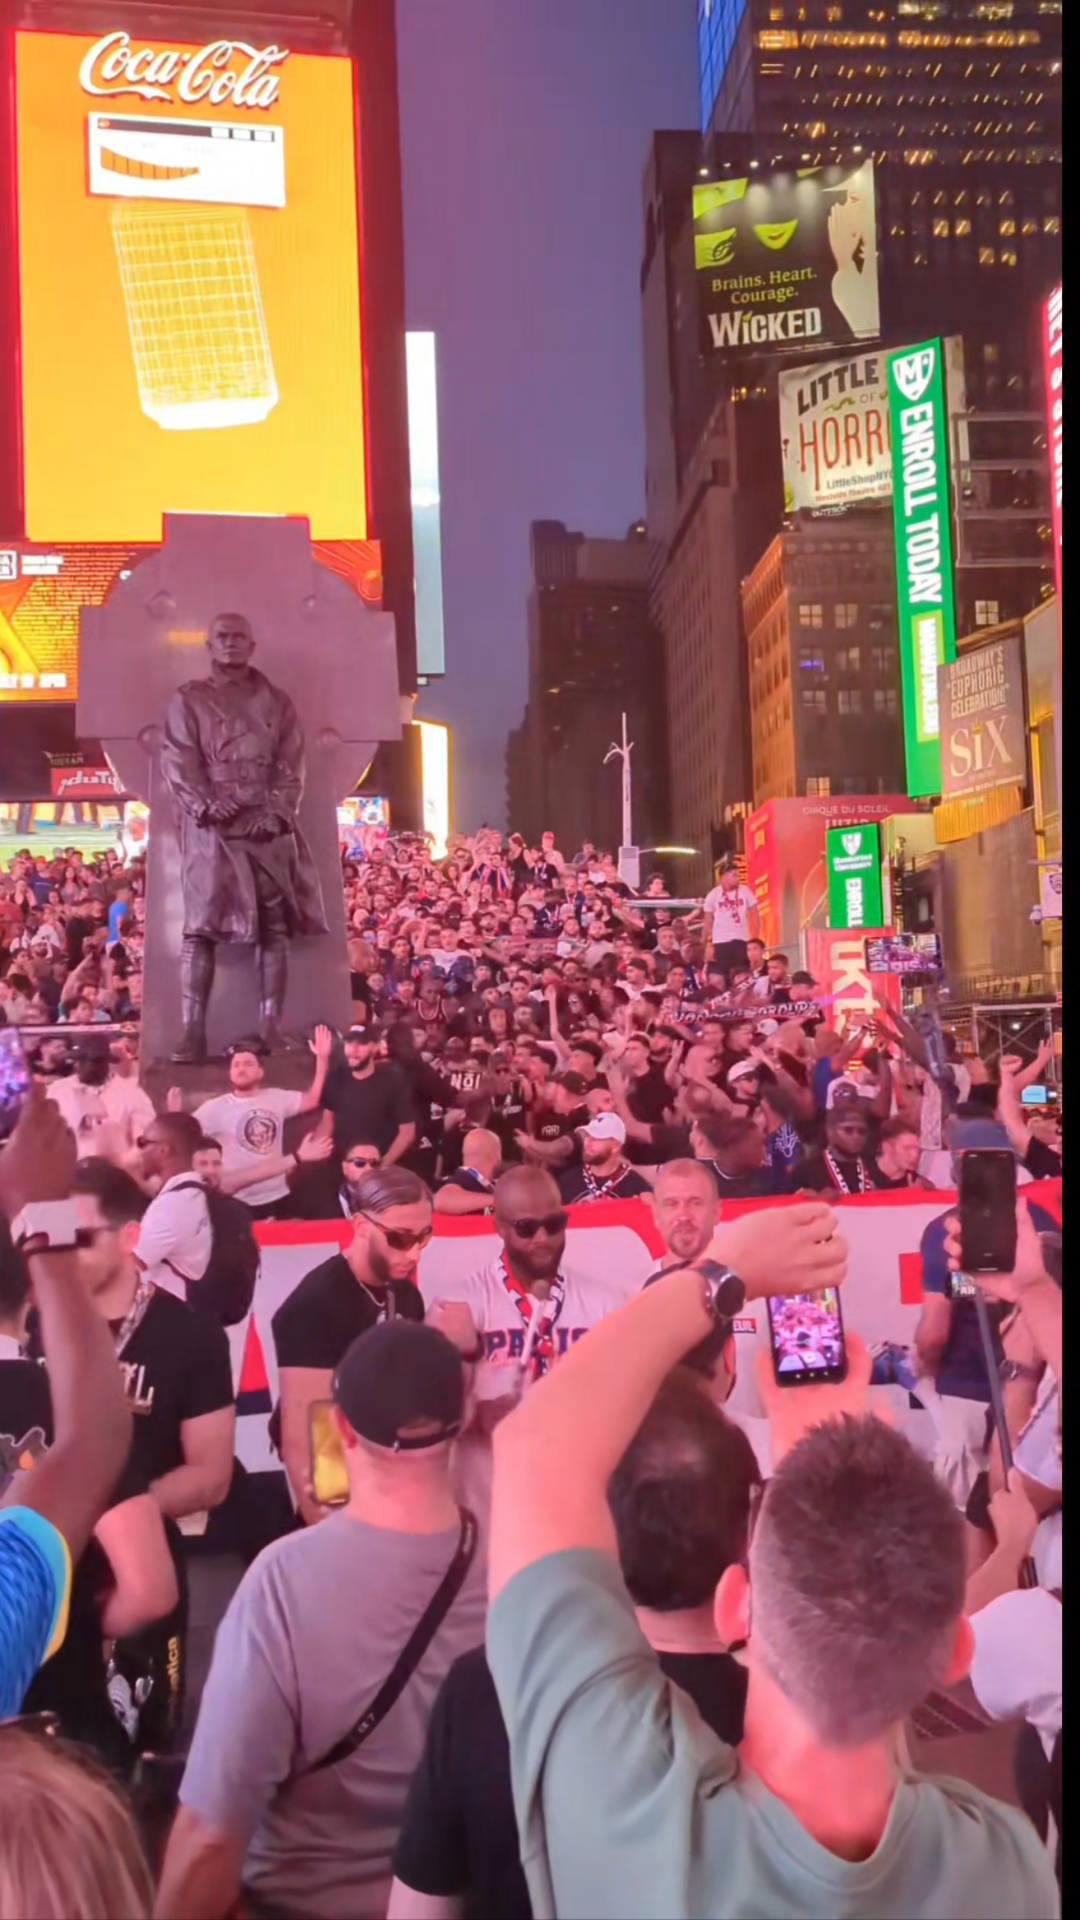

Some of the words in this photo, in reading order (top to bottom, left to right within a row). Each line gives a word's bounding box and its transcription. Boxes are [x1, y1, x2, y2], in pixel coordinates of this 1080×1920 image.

[79, 31, 289, 107] Coca-Cola
[711, 274, 766, 292] Brains.
[769, 267, 817, 285] Heart.
[730, 285, 799, 305] Courage.
[797, 358, 879, 416] LITTLE
[860, 391, 877, 404] OF
[900, 401, 938, 517] ENROLL
[905, 512, 944, 604] TODAY
[950, 646, 1003, 679] BROADWAY'S
[802, 806, 839, 816] CIRQUE
[841, 805, 856, 814] DU
[857, 804, 891, 813] SOLEIL
[483, 1327, 590, 1361] PAI
